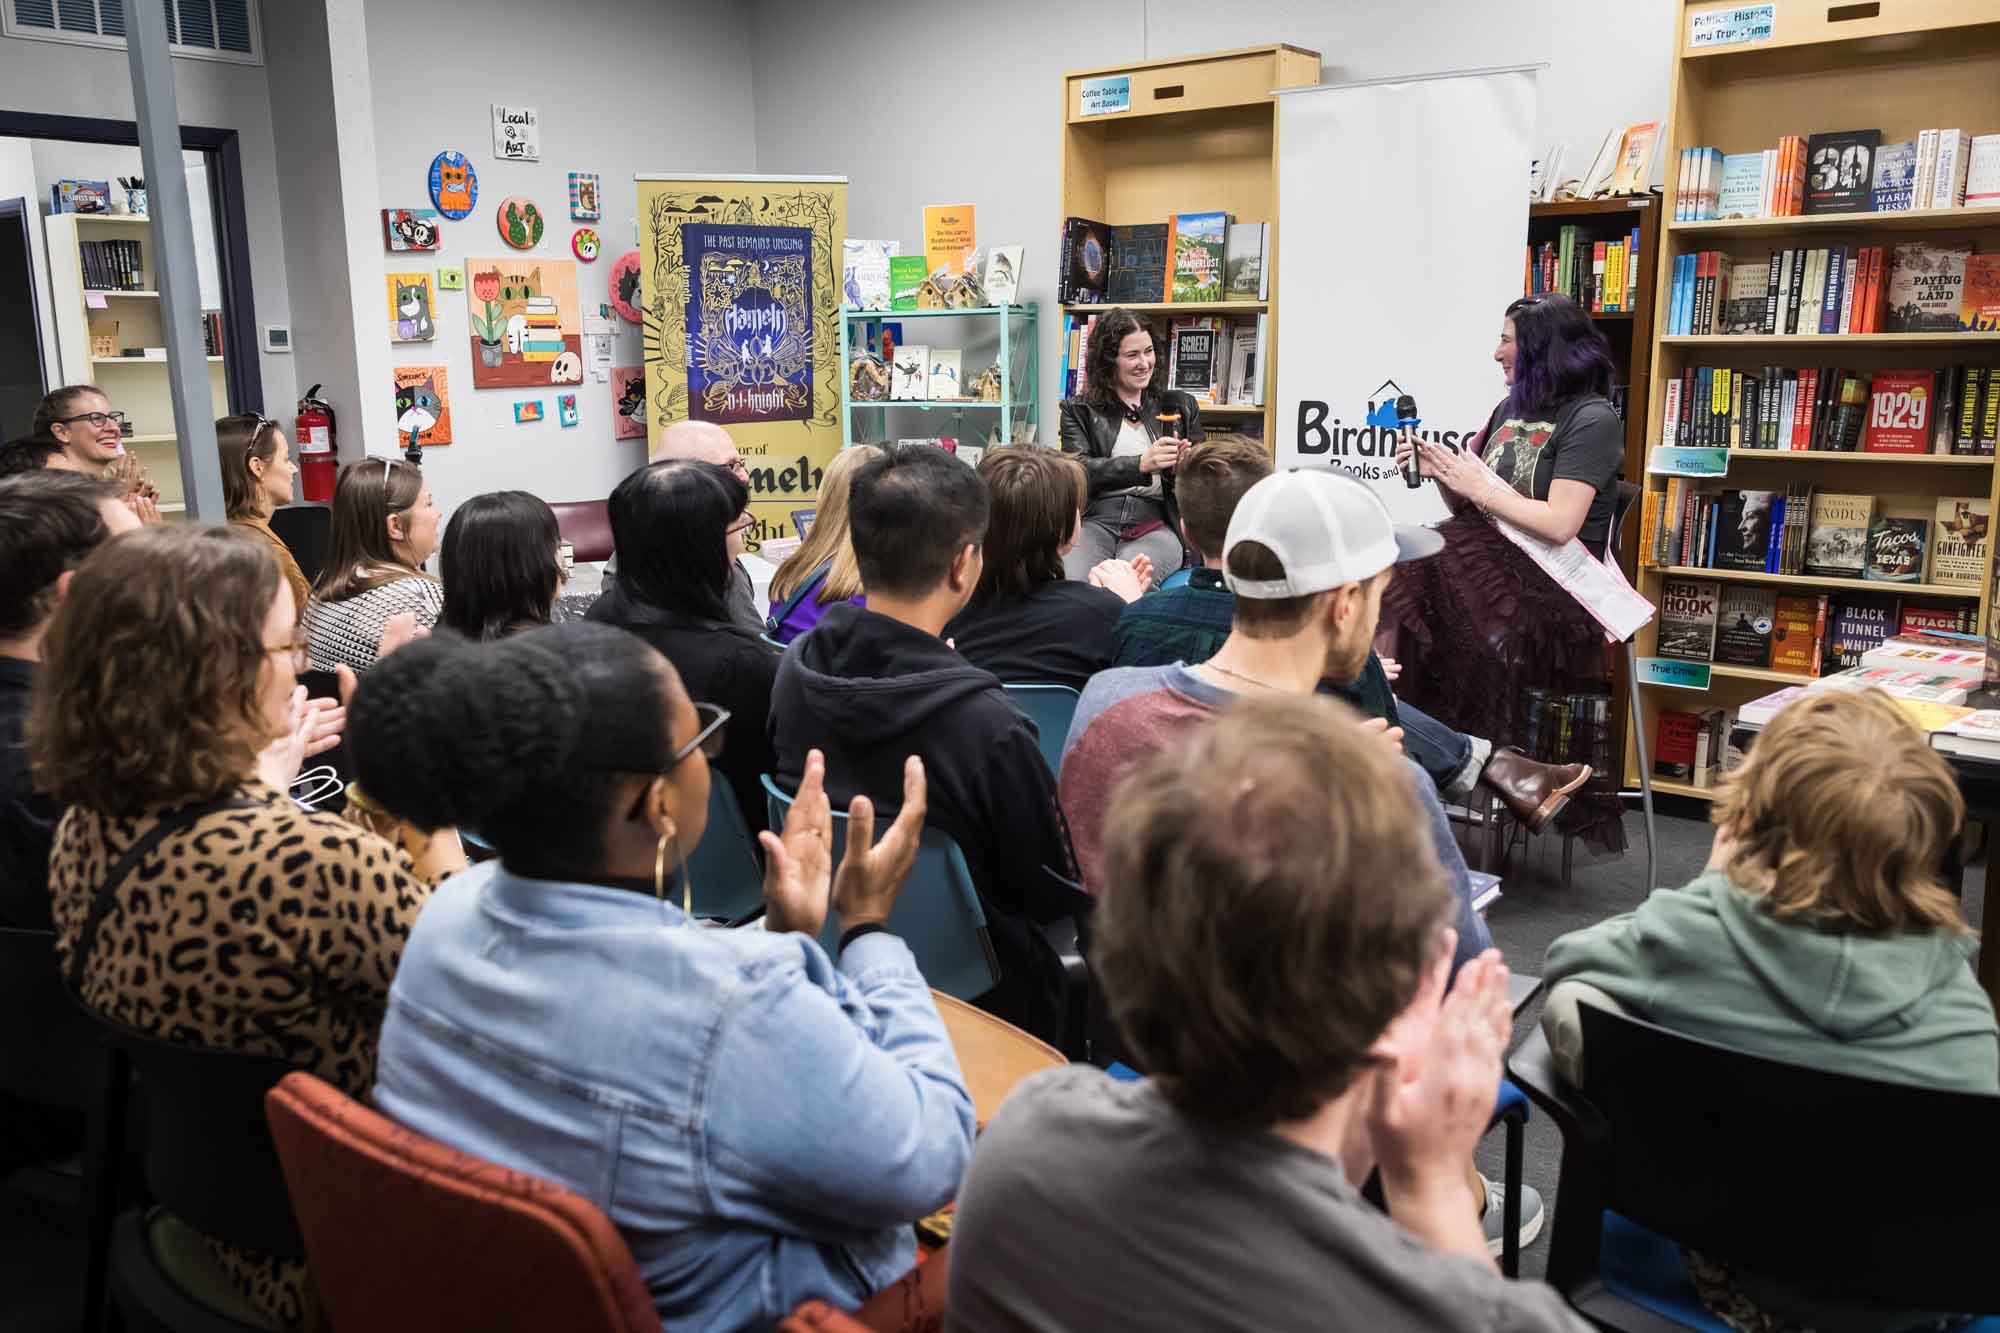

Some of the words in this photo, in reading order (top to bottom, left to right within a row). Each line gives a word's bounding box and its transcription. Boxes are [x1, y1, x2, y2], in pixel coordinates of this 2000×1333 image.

[1081, 90, 1100, 98] Coffee
[1102, 87, 1118, 96] Table
[1090, 101, 1101, 109] Art
[502, 107, 529, 126] Local
[1876, 191, 1913, 203] MARIA
[1878, 202, 1909, 214] RESSA
[703, 234, 716, 248] THE
[718, 234, 736, 249] PAST
[736, 236, 771, 250] REMAINS
[772, 237, 804, 251] UNSUNG
[1178, 258, 1220, 269] WANDERLUST
[1830, 254, 1840, 285] FREEDOM
[1912, 275, 1961, 286] PAYING
[1826, 285, 1837, 311] SEASON
[1917, 291, 1954, 301] LAND
[725, 302, 787, 338] Hameln
[1180, 335, 1210, 353] SCREEN
[1761, 388, 1771, 422] SURVIVOR
[1770, 388, 1780, 422] SURVIVOR
[1962, 383, 1976, 423] DETERMINED
[1871, 392, 1927, 430] 1929
[1961, 424, 1973, 438] SPY
[1983, 424, 1995, 438] SPY
[1330, 459, 1380, 480] ooks
[1382, 464, 1399, 480] and
[1815, 507, 1866, 520] EXODUS
[1873, 530, 1919, 549] Tacos
[1875, 554, 1911, 566] TEXAS
[1664, 584, 1698, 599] RED
[1663, 598, 1713, 615] HOOK
[1845, 607, 1885, 621] BLACK
[1840, 622, 1887, 638] TUNNEL
[1904, 615, 1956, 630] WHACK
[1650, 663, 1671, 673] True
